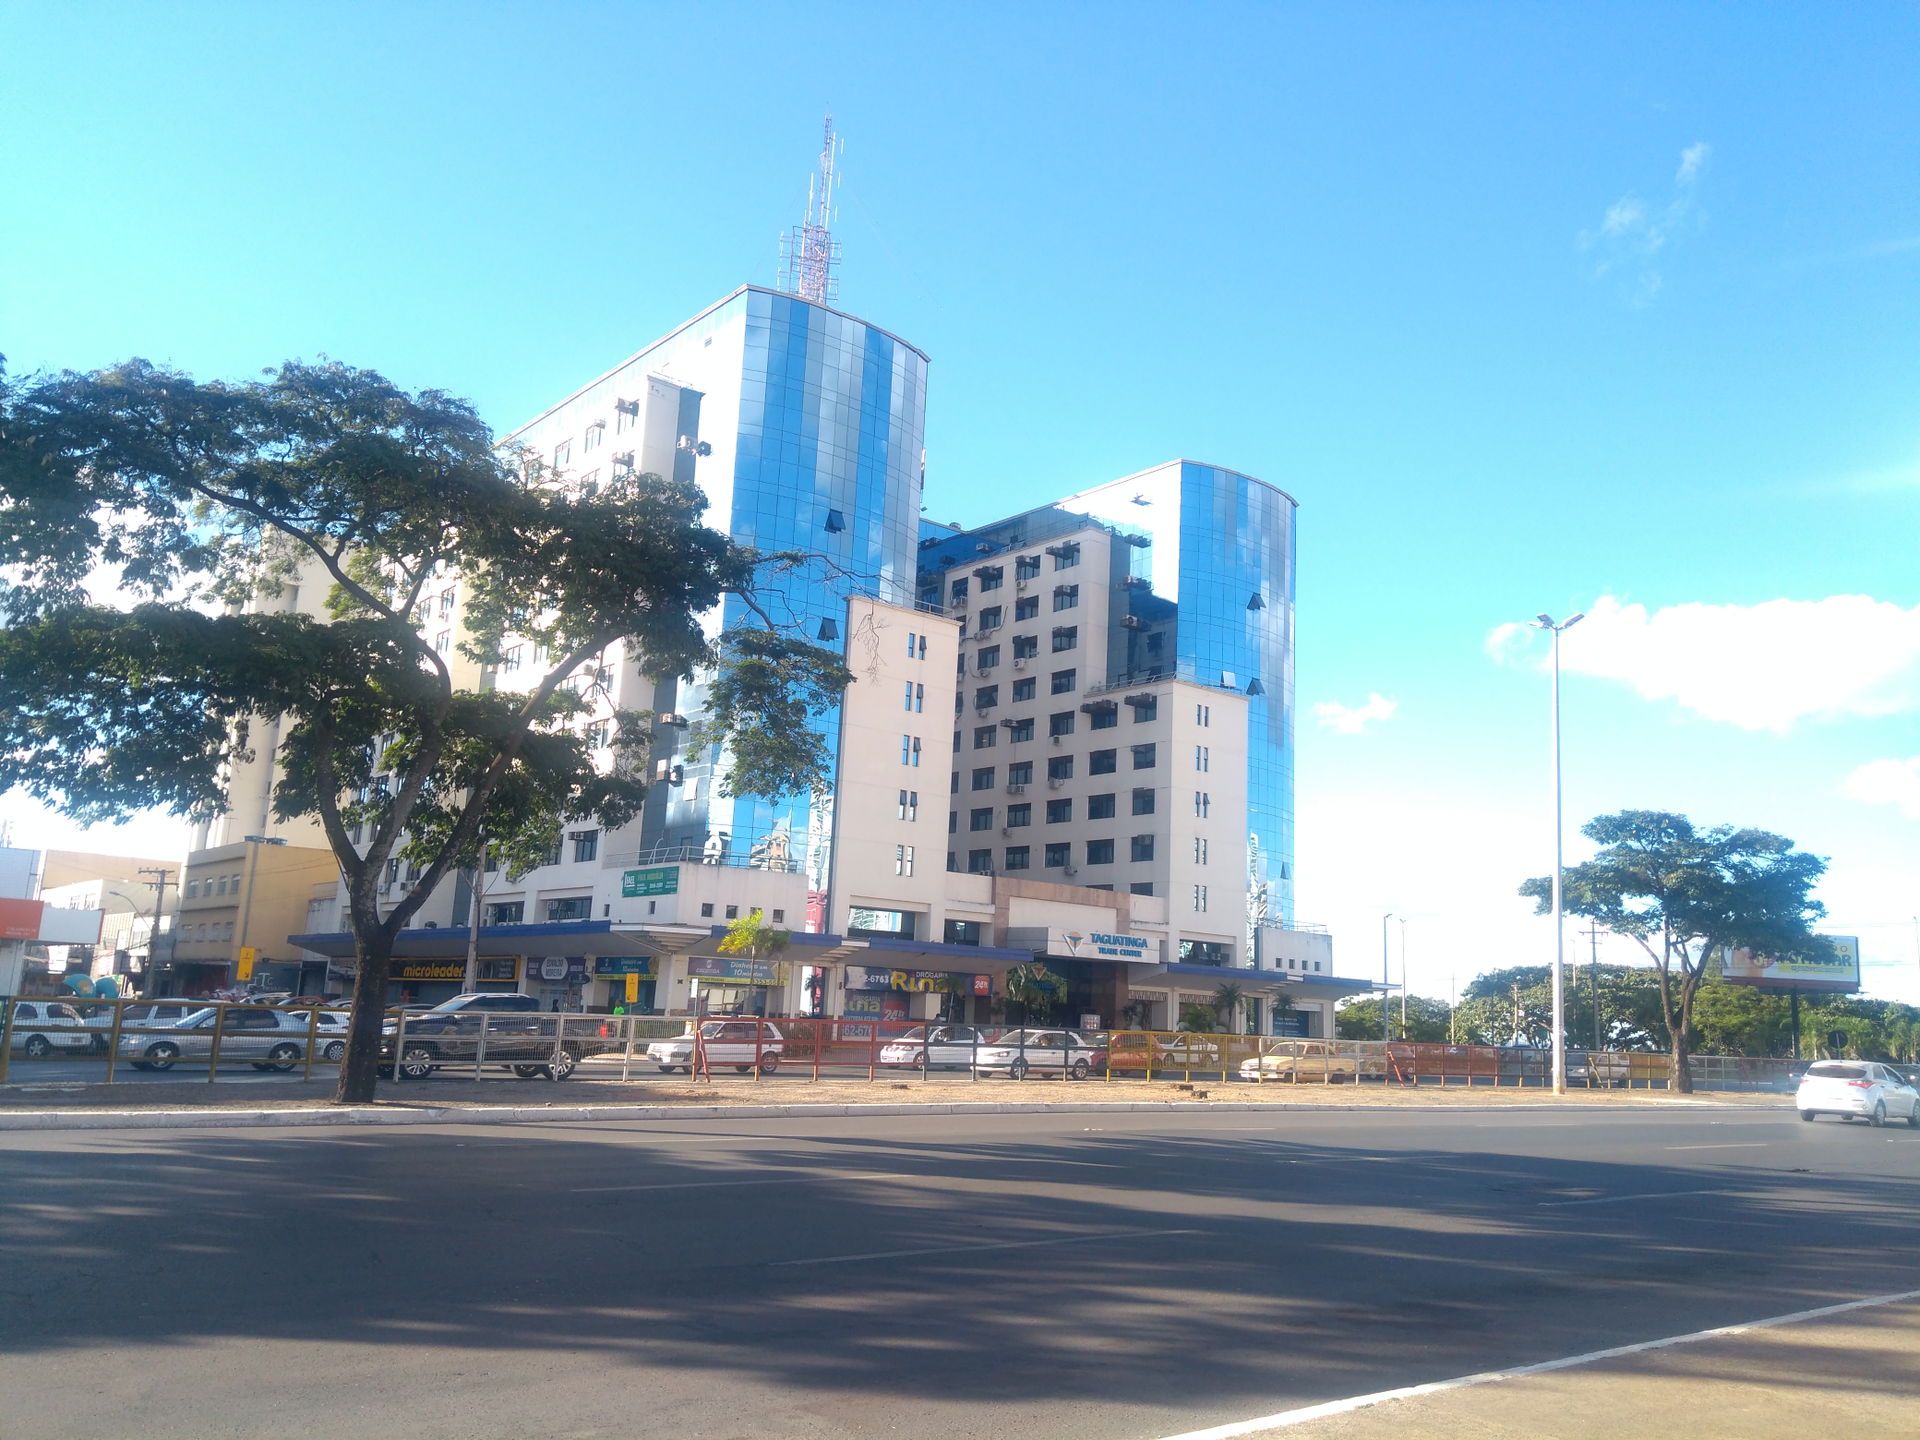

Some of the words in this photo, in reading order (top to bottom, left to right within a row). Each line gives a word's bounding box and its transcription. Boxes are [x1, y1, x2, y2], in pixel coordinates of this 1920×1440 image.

[1090, 933, 1148, 948] TAGUATINGA
[1097, 947, 1118, 955] TRADE
[1119, 949, 1142, 957] CENTER
[403, 962, 465, 978] microleader
